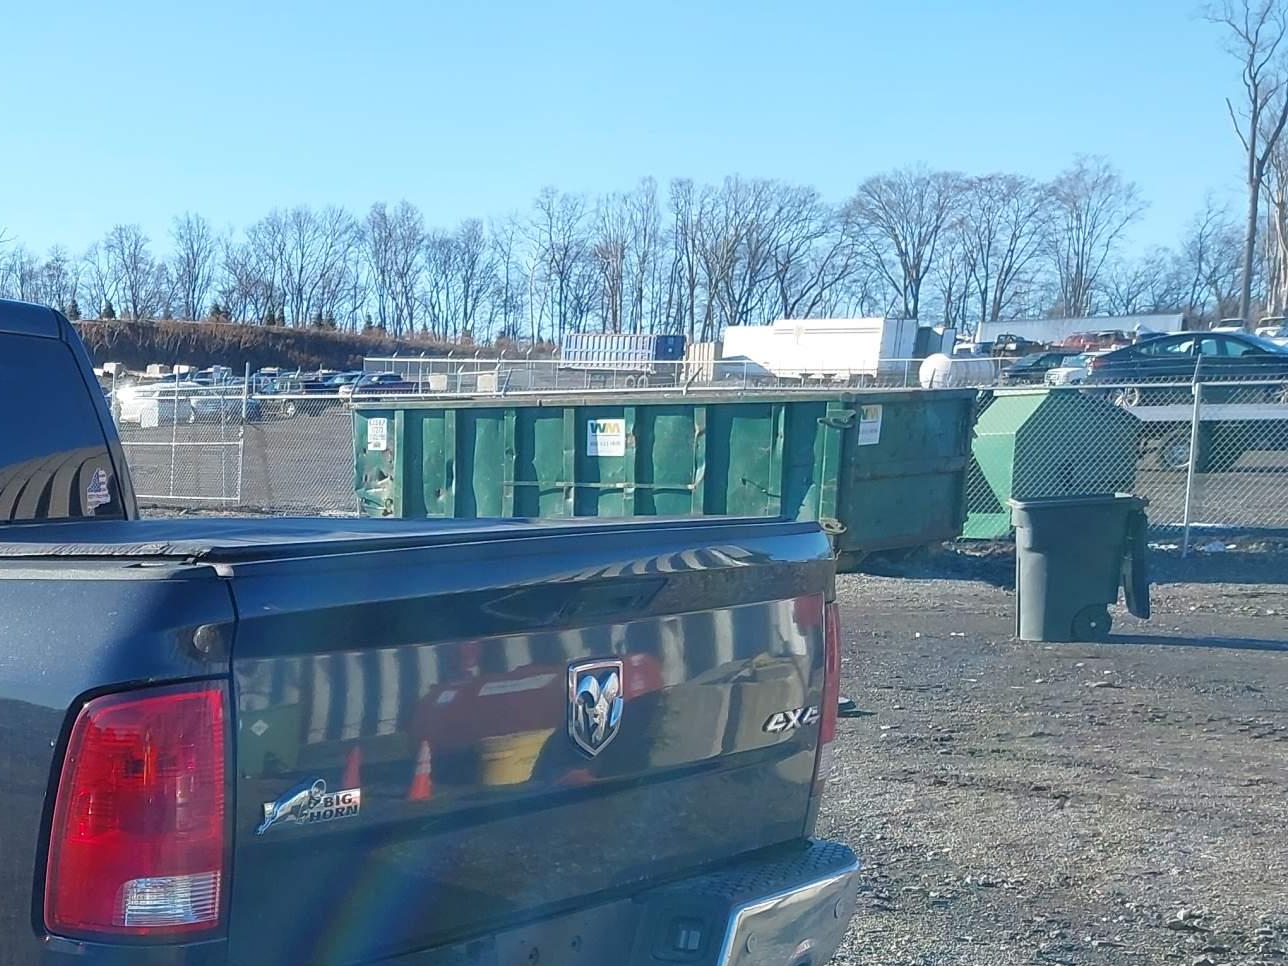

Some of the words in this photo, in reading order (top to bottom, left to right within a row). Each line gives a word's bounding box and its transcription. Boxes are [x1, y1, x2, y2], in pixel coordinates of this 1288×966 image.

[590, 422, 621, 434] WM
[323, 793, 353, 808] BIG
[309, 804, 359, 821] HORN
